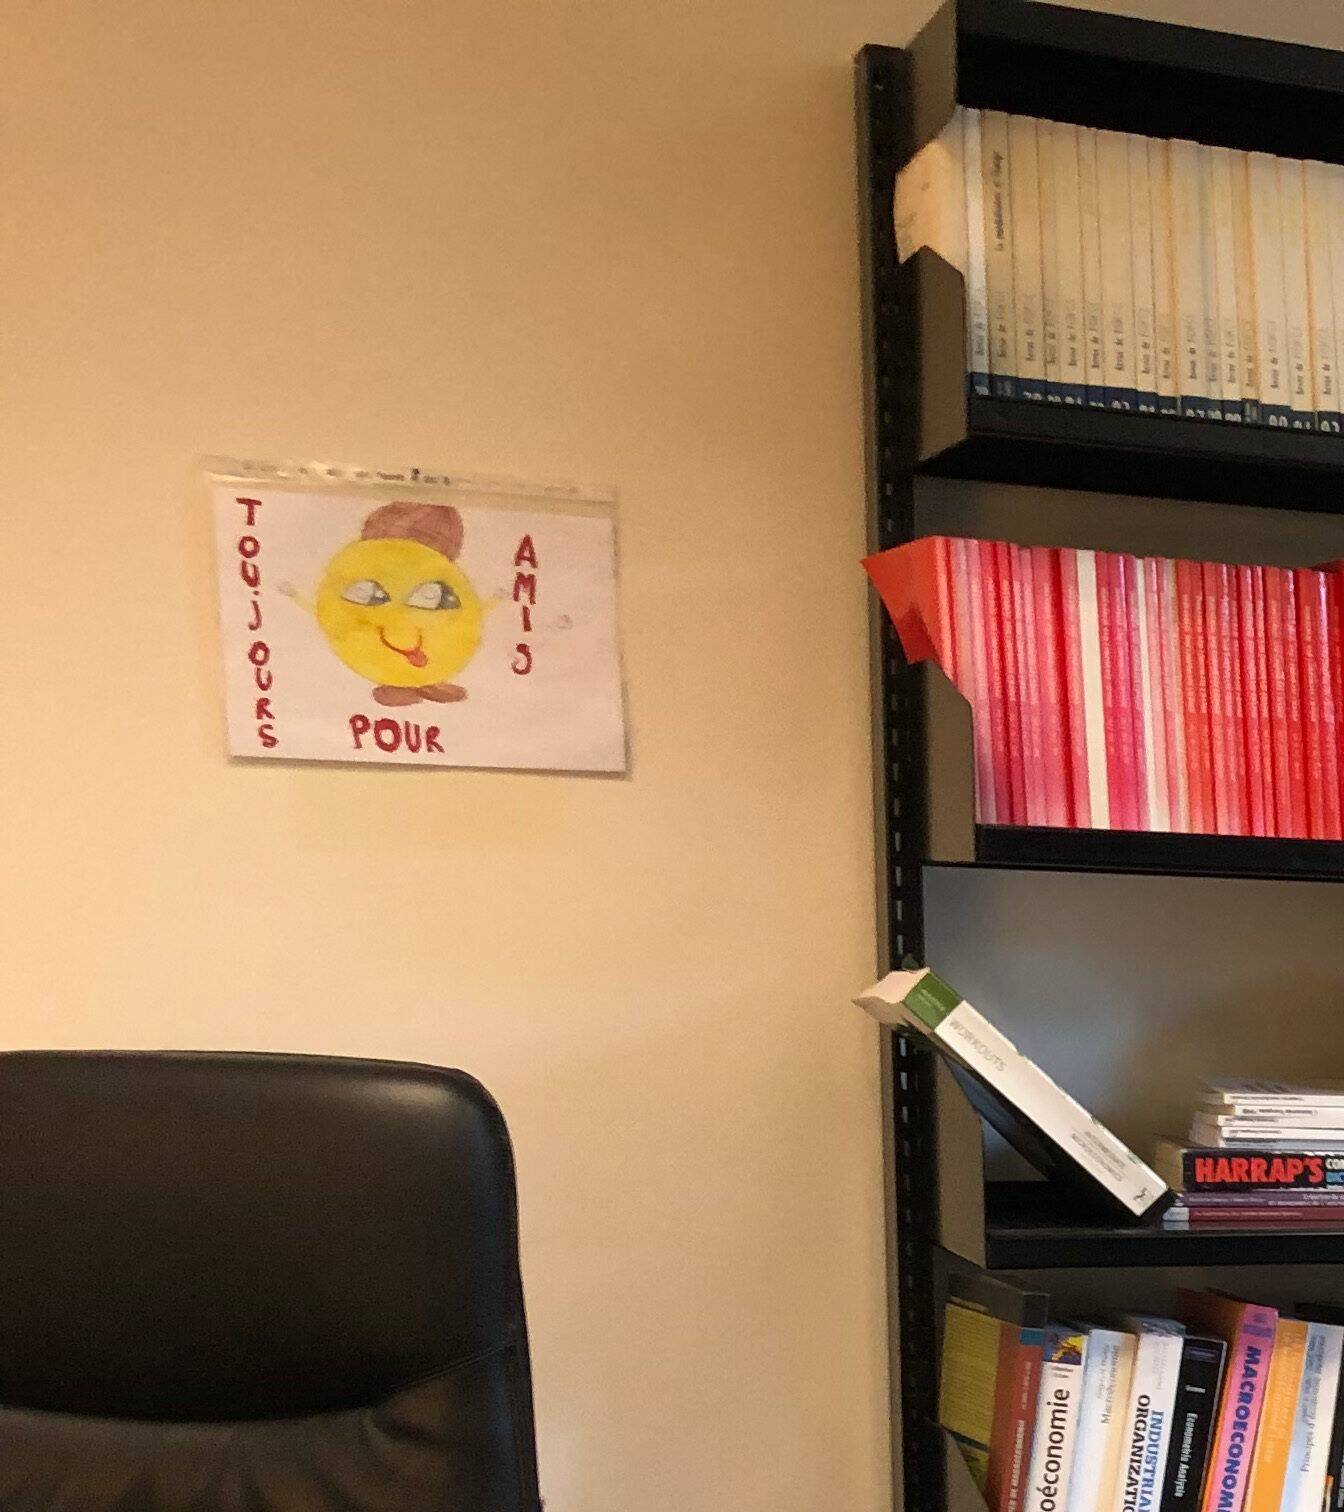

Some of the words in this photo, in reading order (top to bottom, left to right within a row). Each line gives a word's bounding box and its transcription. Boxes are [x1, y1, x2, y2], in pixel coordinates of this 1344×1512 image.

[235, 497, 280, 748] TOUJOURS
[510, 533, 540, 676] AMIS
[348, 713, 445, 753] POUR
[1194, 1157, 1325, 1184] HARRAP'S
[1179, 1413, 1198, 1462] Econometric
[1173, 1463, 1190, 1497] Analysis
